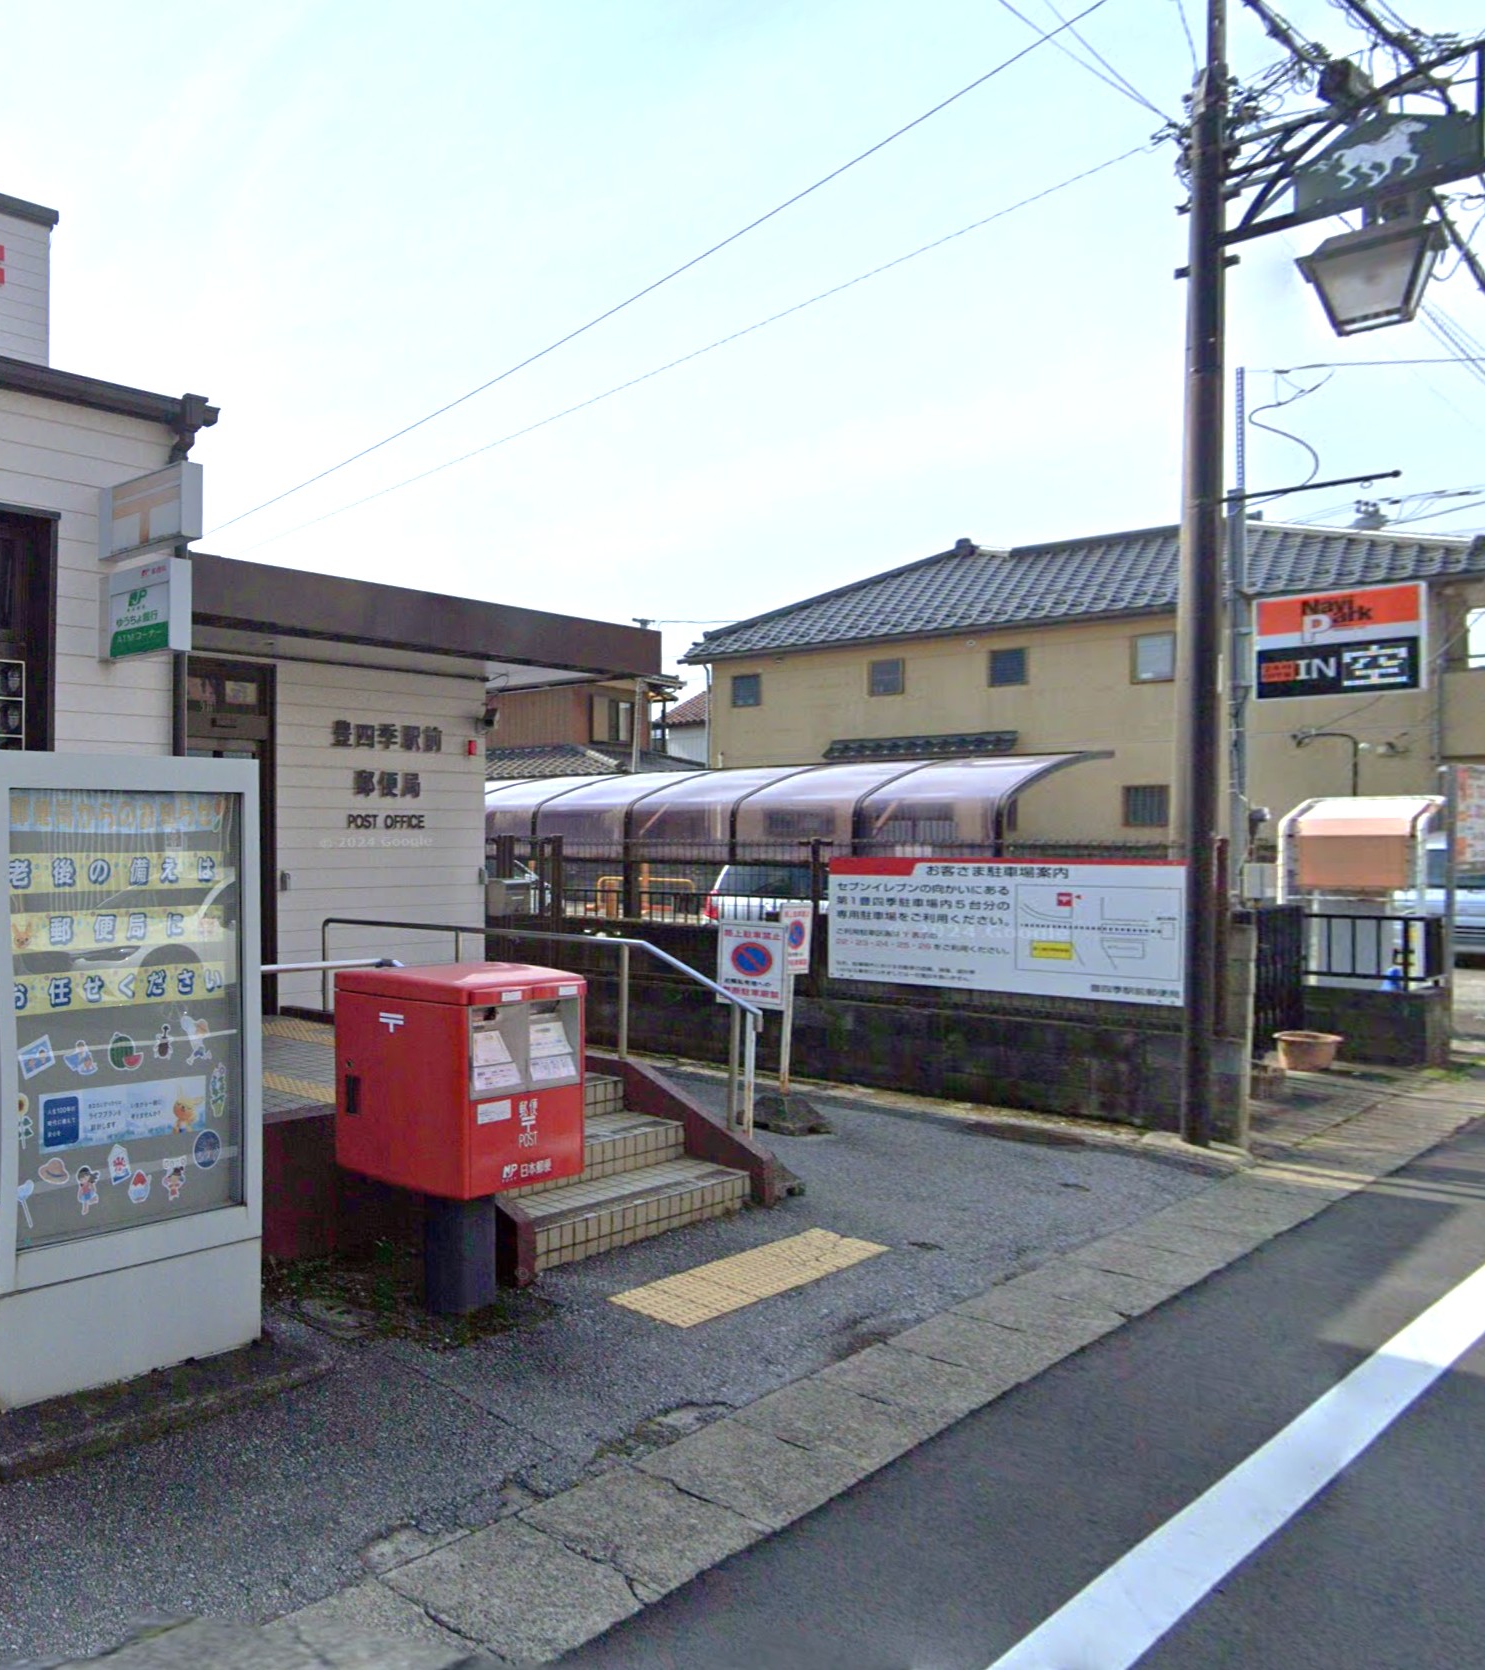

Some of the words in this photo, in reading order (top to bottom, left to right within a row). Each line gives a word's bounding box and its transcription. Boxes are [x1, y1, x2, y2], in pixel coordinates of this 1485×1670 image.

[1301, 594, 1355, 616] Navi
[1296, 656, 1337, 681] IN
[330, 719, 443, 752] 豊四季駅前
[353, 769, 421, 798] 郵便局
[346, 813, 379, 830] POST
[384, 814, 426, 830] OFFICE
[9, 855, 216, 889] 老後の備えは
[926, 864, 1070, 880] お客さま駐車場案内
[836, 882, 1011, 897] セブンイレブンの向かいにある
[49, 911, 184, 946] 郵便局に
[14, 967, 223, 1010] お任せください
[519, 1130, 538, 1149] POST
